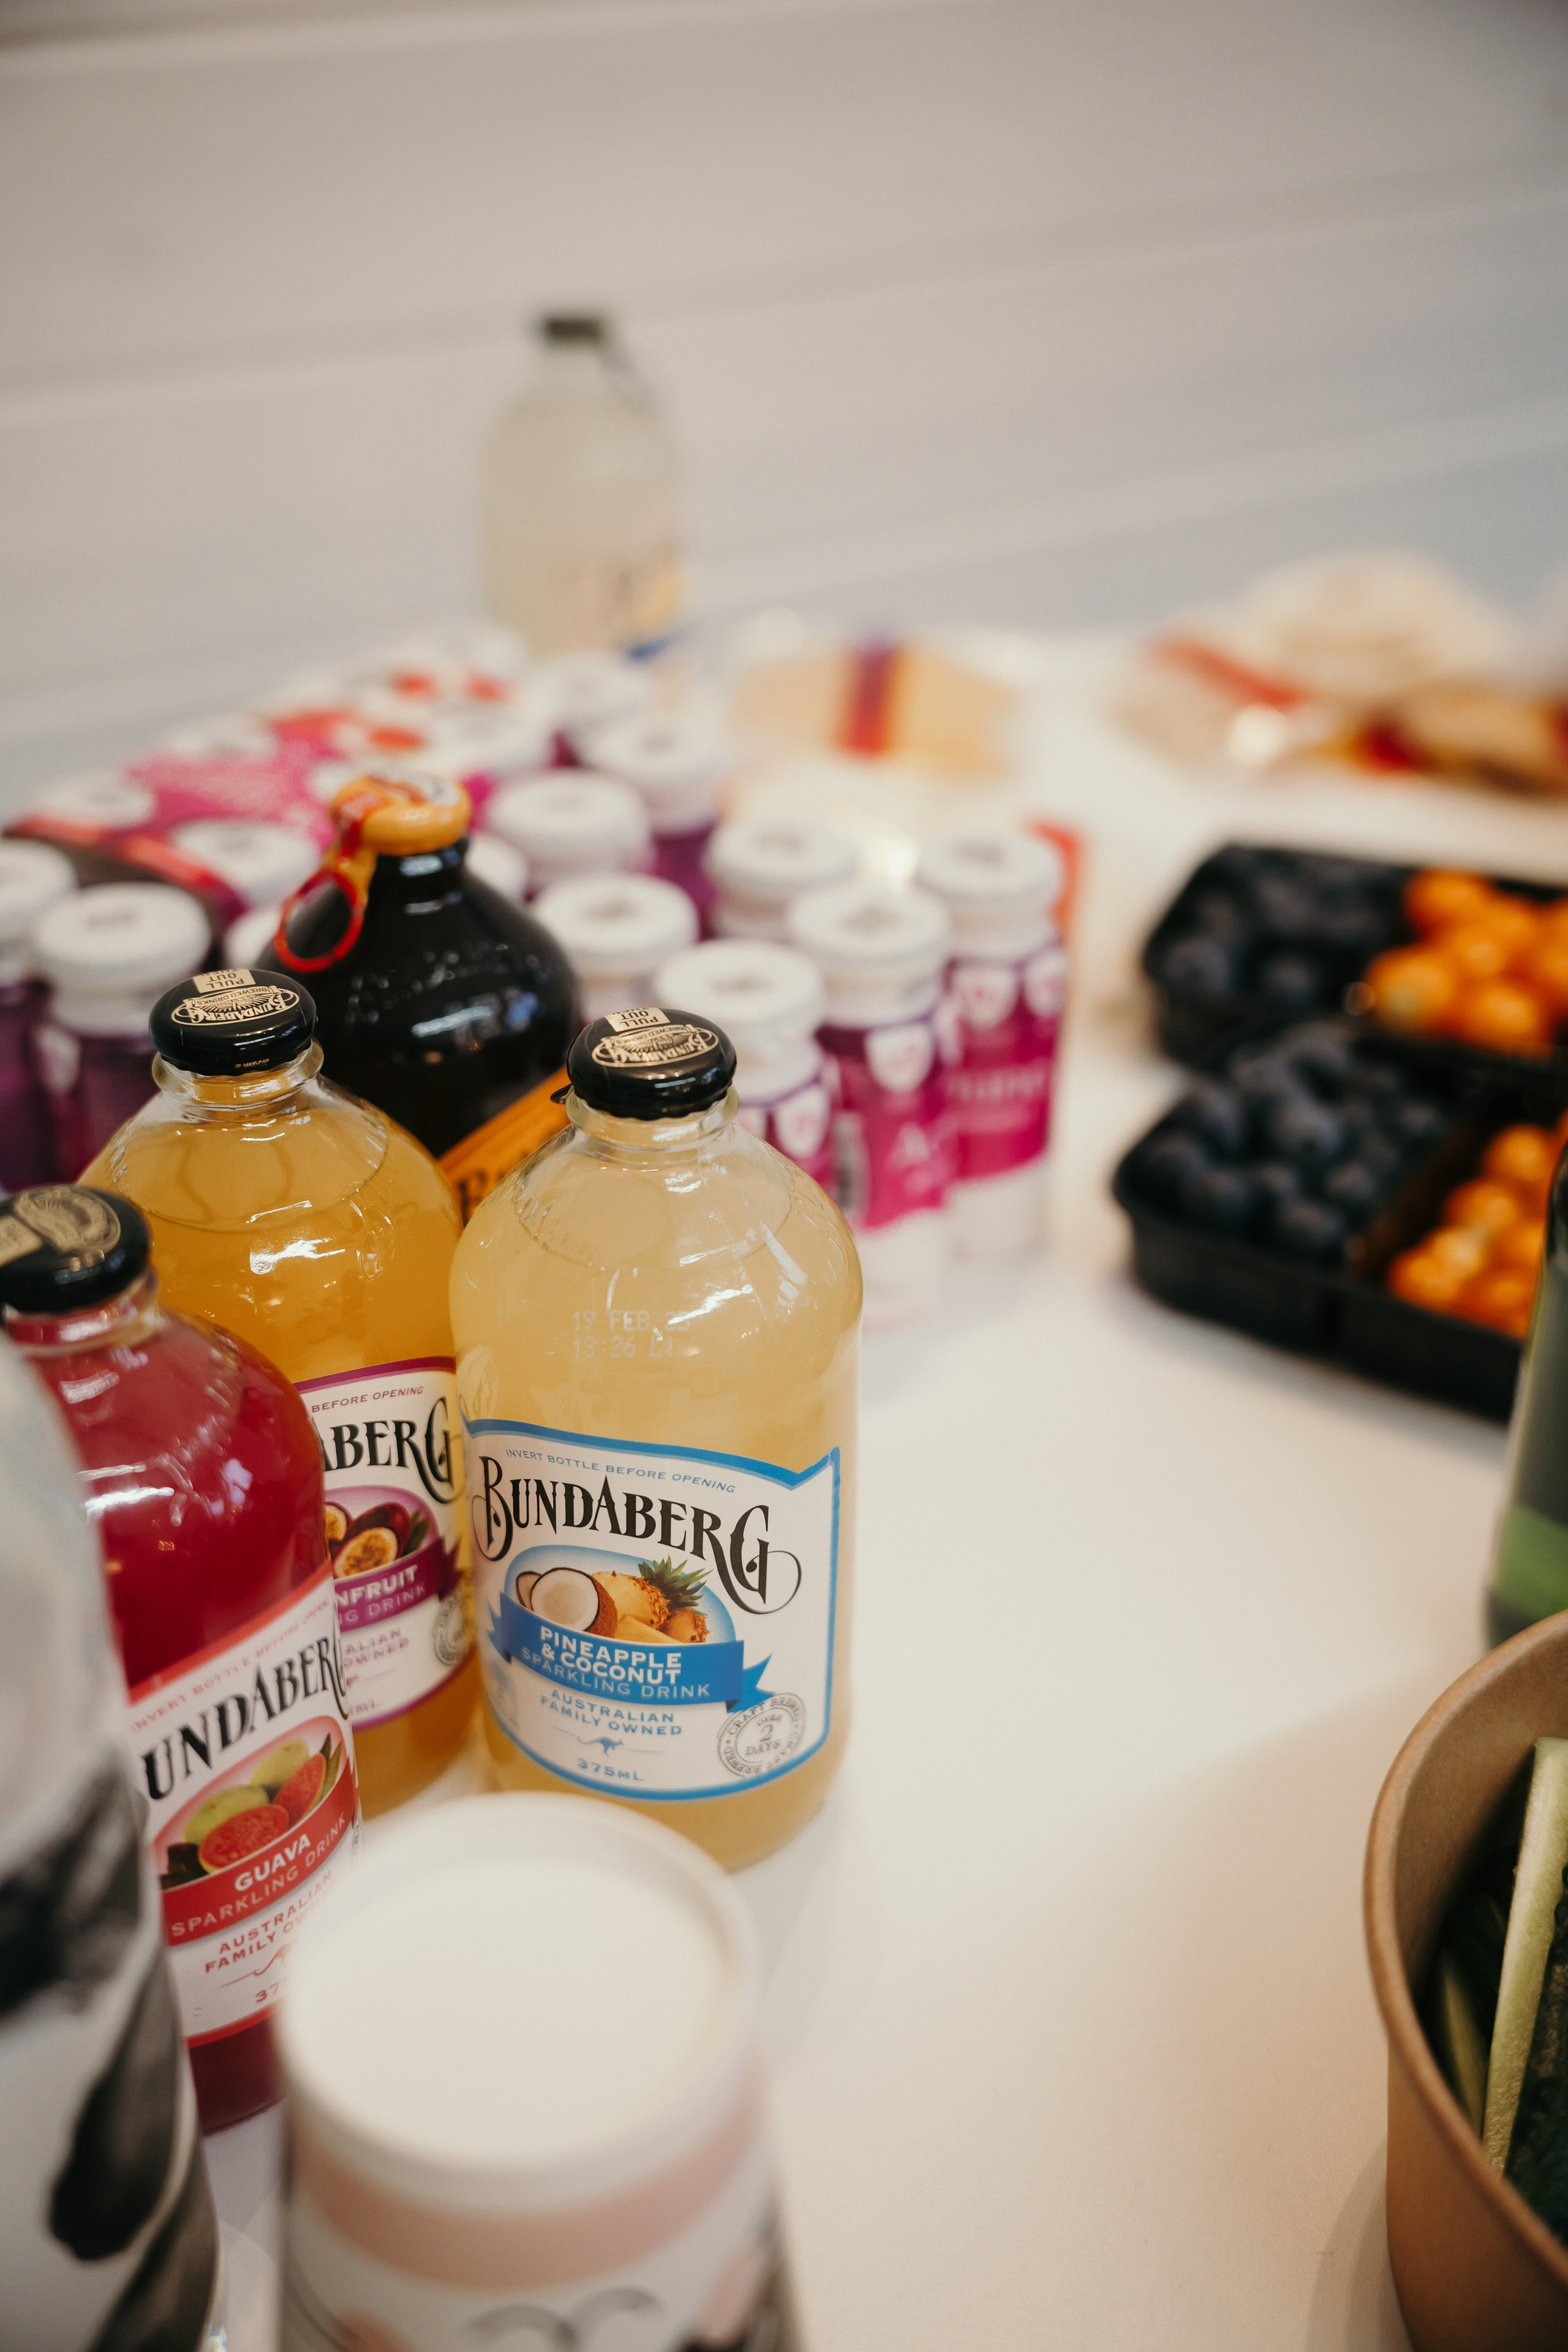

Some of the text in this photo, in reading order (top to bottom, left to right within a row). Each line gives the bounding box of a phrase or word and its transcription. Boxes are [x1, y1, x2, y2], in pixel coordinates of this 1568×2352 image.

[206, 979, 245, 988] PULL
[209, 973, 236, 981] OUT
[187, 993, 293, 1023] BUNDABERG
[197, 987, 267, 1006] BREWED DRINKS
[620, 1010, 649, 1020] OUT
[620, 1017, 658, 1027] PULL
[311, 1386, 424, 1413] BEFORE OPENING
[505, 1449, 736, 1494] INVERT BOTTLE BEFORE OPENING
[472, 1455, 802, 1615] BUNDABERG
[540, 1625, 682, 1668] PINEAPPLE
[521, 1646, 710, 1698] SPARKLING DRINK
[541, 1643, 682, 1684] & COCONUT
[541, 1694, 682, 1735] FAMILY OWNED
[552, 1689, 674, 1722] AUSTRALIAN
[744, 1740, 781, 1755] DAYS
[760, 1724, 774, 1743] 2
[171, 1866, 299, 1937] SPARKLING
[306, 1811, 345, 1868] DRINK
[235, 1833, 311, 1891] GUAVA
[205, 1932, 276, 1973] FAMILY
